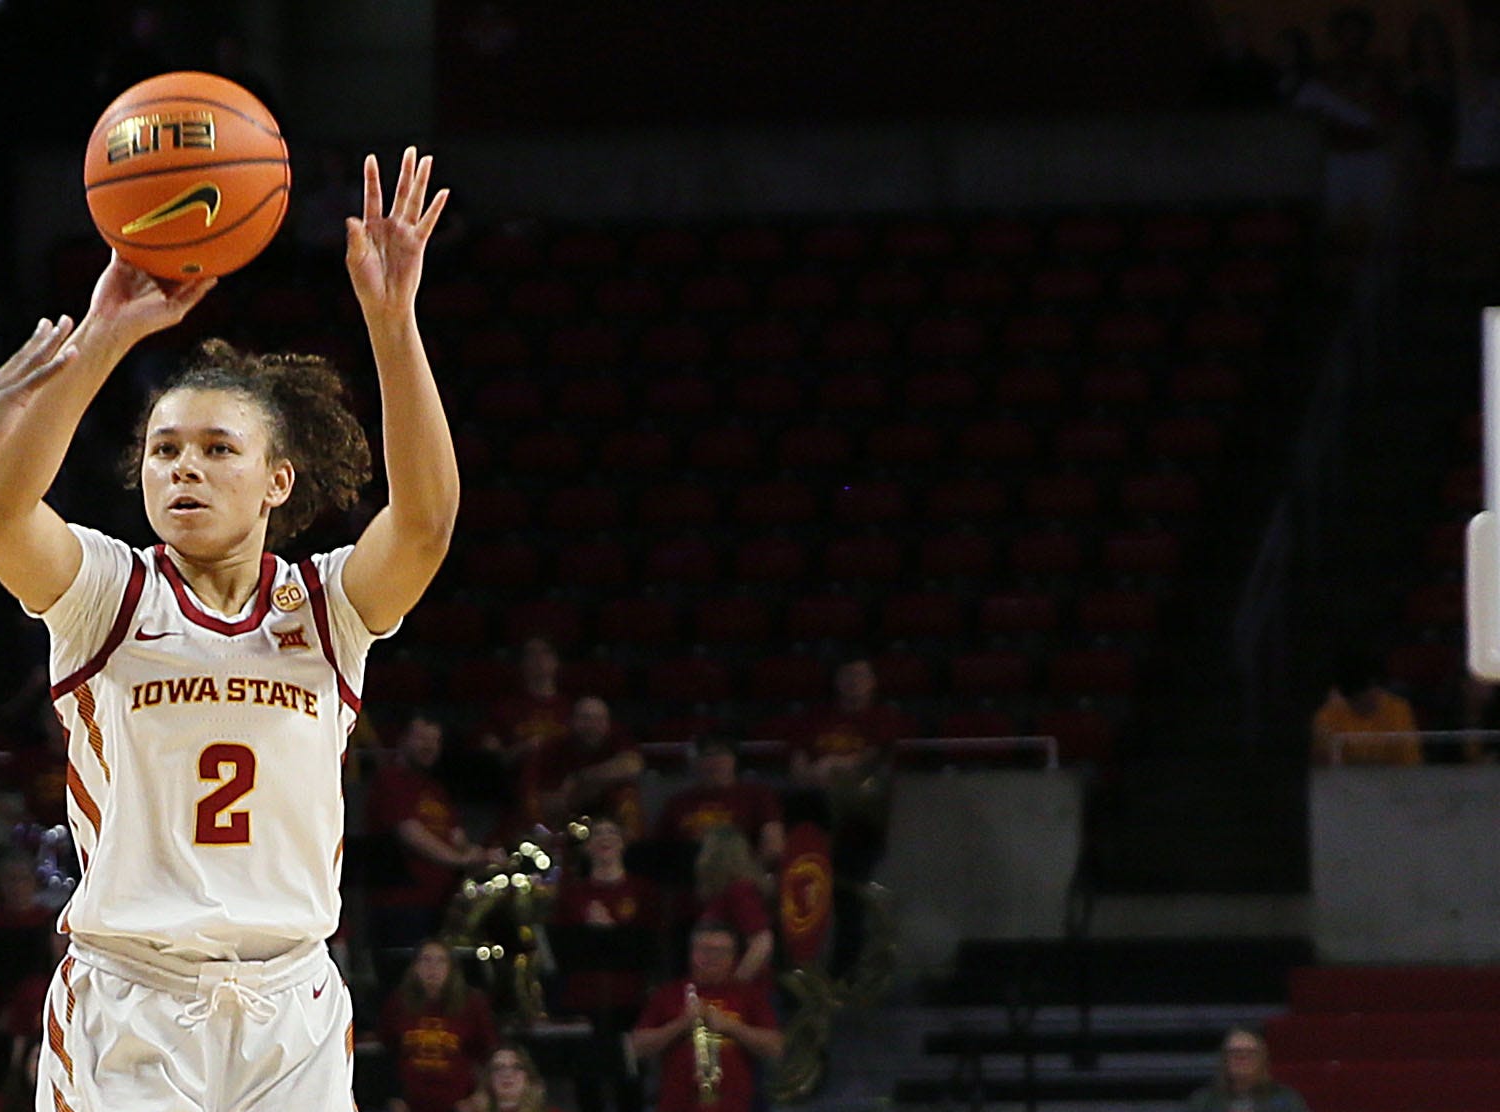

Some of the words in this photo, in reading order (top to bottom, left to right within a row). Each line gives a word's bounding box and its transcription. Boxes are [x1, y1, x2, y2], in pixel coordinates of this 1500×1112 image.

[275, 587, 302, 606] 50
[131, 676, 219, 712] IOWA
[227, 677, 319, 719] STATE
[193, 740, 257, 847] 2
